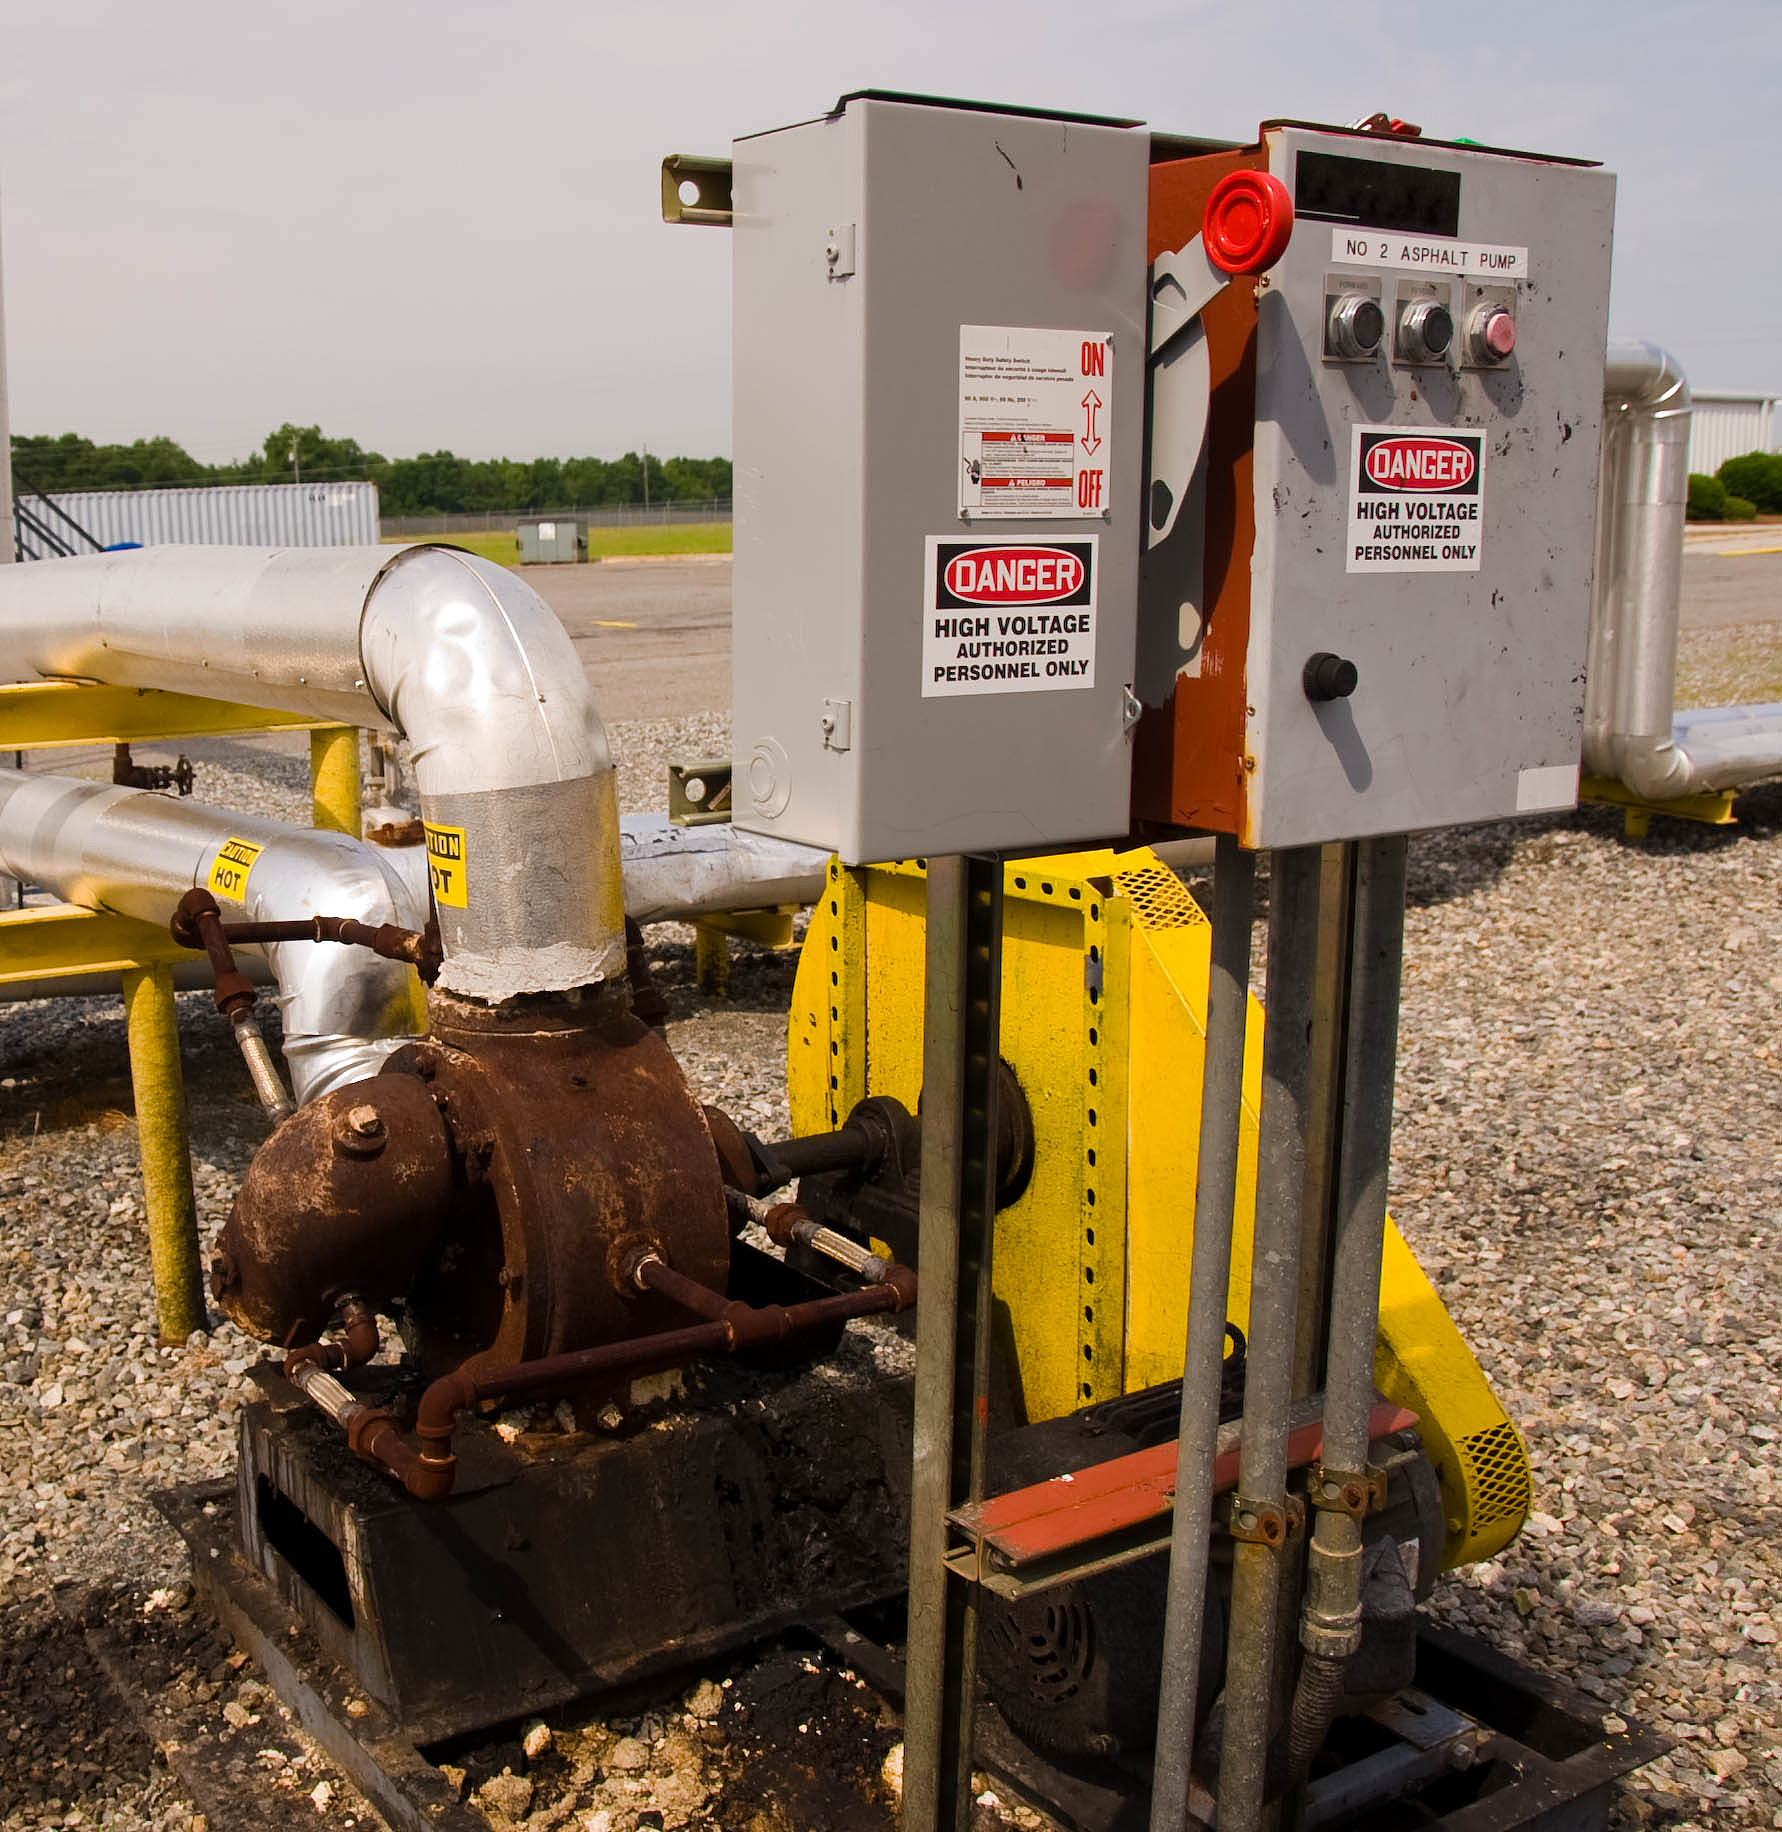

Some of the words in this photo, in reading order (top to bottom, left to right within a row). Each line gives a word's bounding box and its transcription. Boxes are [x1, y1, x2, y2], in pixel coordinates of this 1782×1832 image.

[1346, 239, 1367, 256] NO
[1380, 243, 1388, 259] 2
[1400, 246, 1468, 266] ASPHALT
[1480, 253, 1516, 270] PUMP
[1081, 341, 1105, 377] ON
[1373, 448, 1468, 481] DANGER
[1078, 469, 1104, 508] OFF
[1357, 502, 1400, 520] HIGH
[1405, 502, 1478, 520] VOLTAGE
[1373, 525, 1461, 540] AUTHORIZED
[1355, 545, 1438, 560] PERSONNEL
[1441, 545, 1476, 560] ONLY
[955, 558, 1076, 593] DANGER
[935, 617, 990, 638] HIGH
[997, 614, 1090, 636] VOLTAGE
[956, 639, 1069, 659] AUTHORIZED
[934, 662, 1040, 682] PERSONNEL
[1045, 660, 1089, 677] ONLY
[427, 830, 459, 857] TION
[215, 866, 241, 892] HOT
[431, 865, 452, 894] OT
